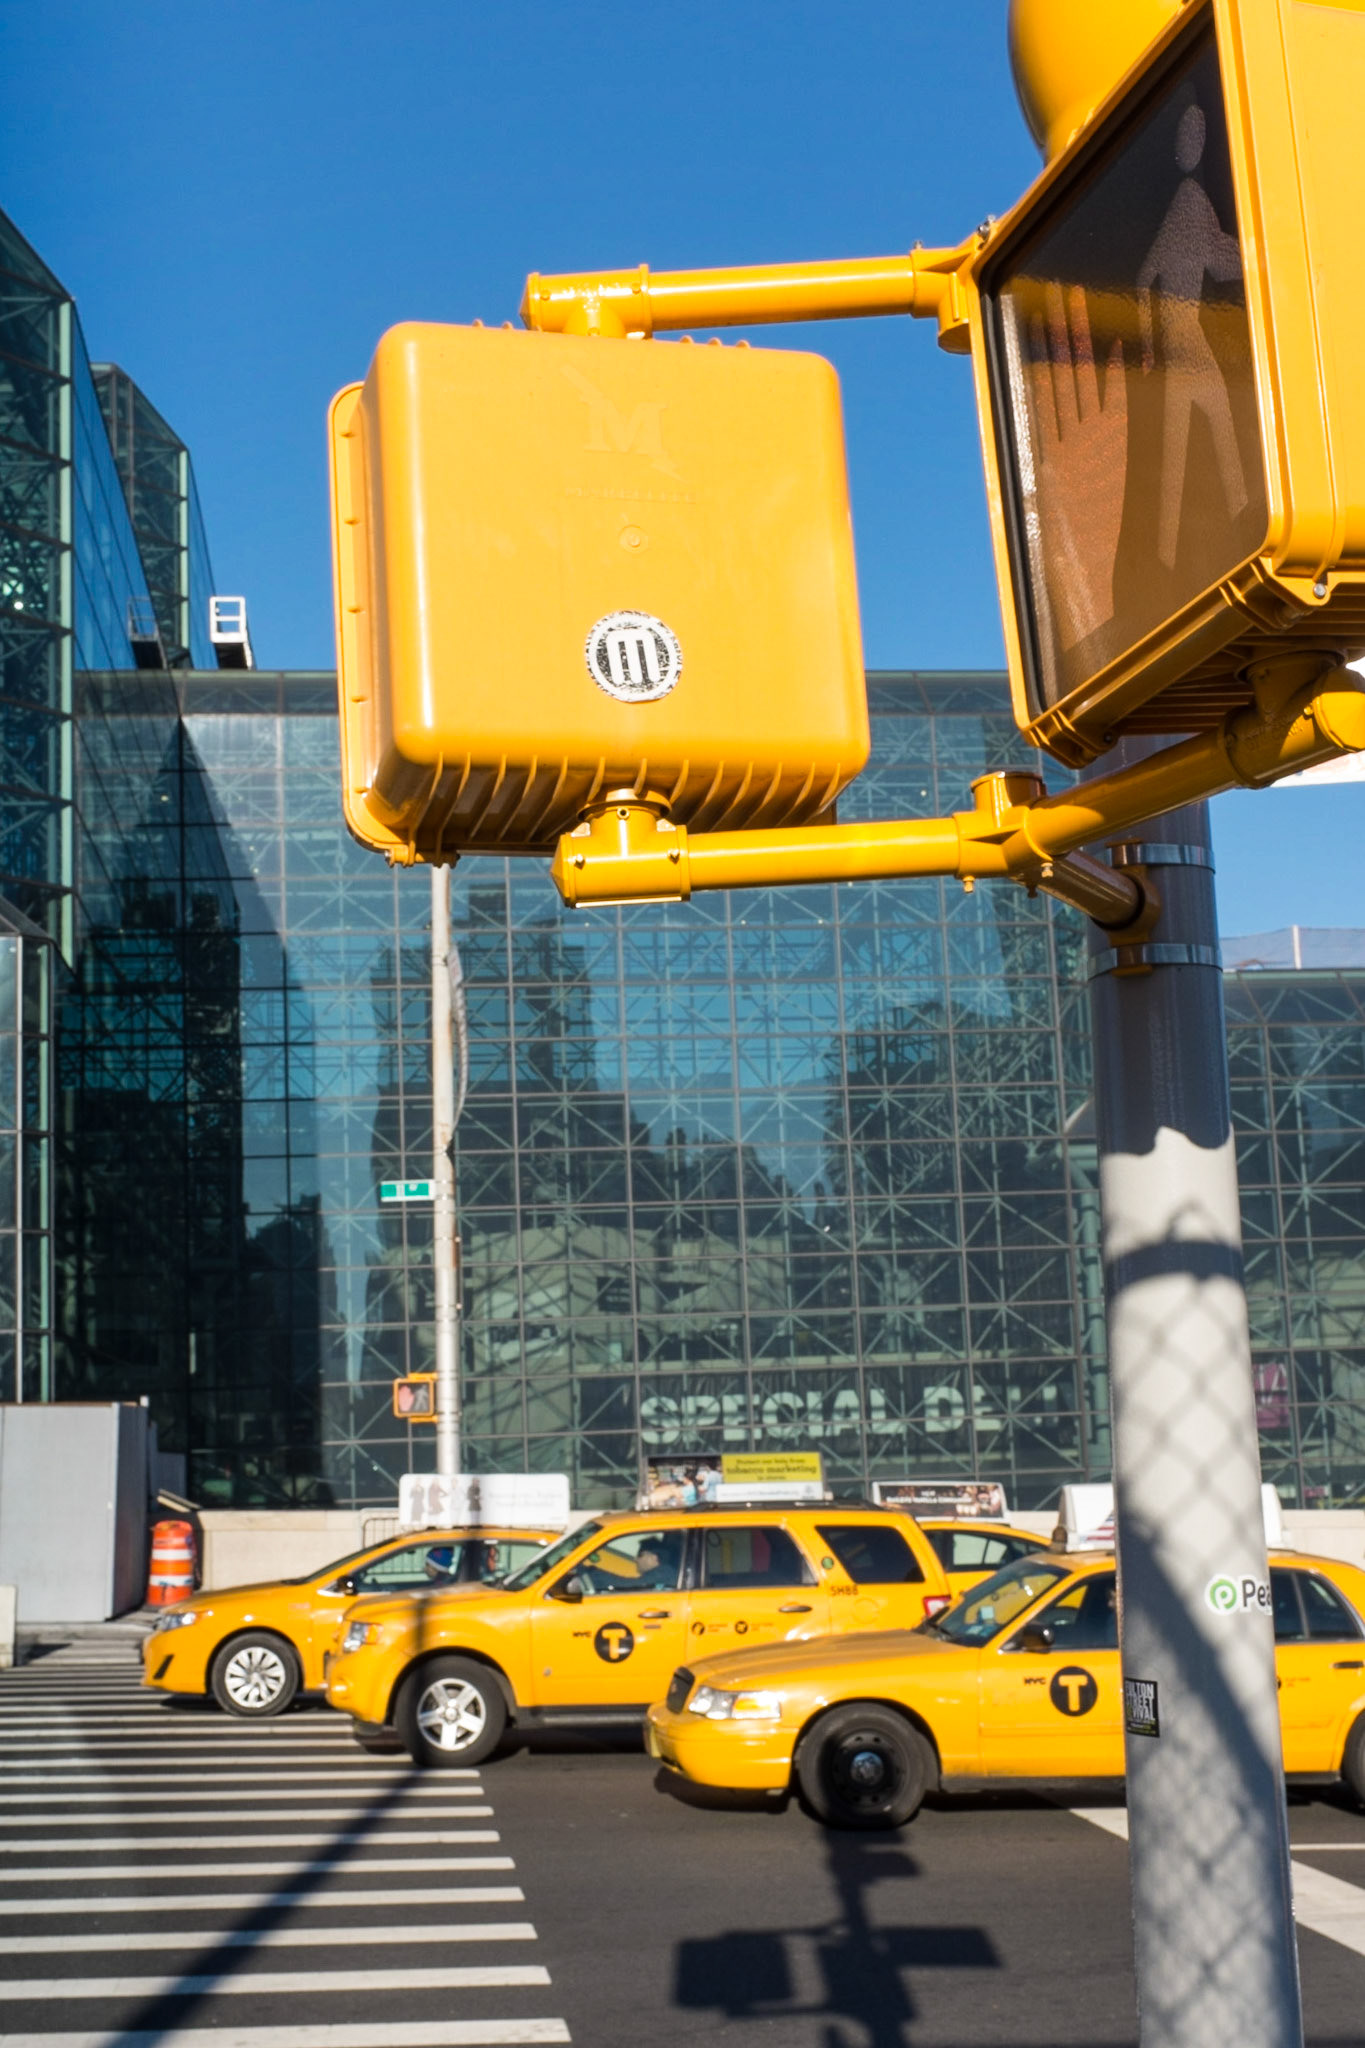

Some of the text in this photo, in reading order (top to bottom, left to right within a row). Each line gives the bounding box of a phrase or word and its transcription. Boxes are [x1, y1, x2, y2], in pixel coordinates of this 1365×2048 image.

[640, 1388, 907, 1445] SPECIAL
[766, 1463, 817, 1474] marketing
[602, 1629, 627, 1660] T
[1024, 1674, 1088, 1712] NYC T
